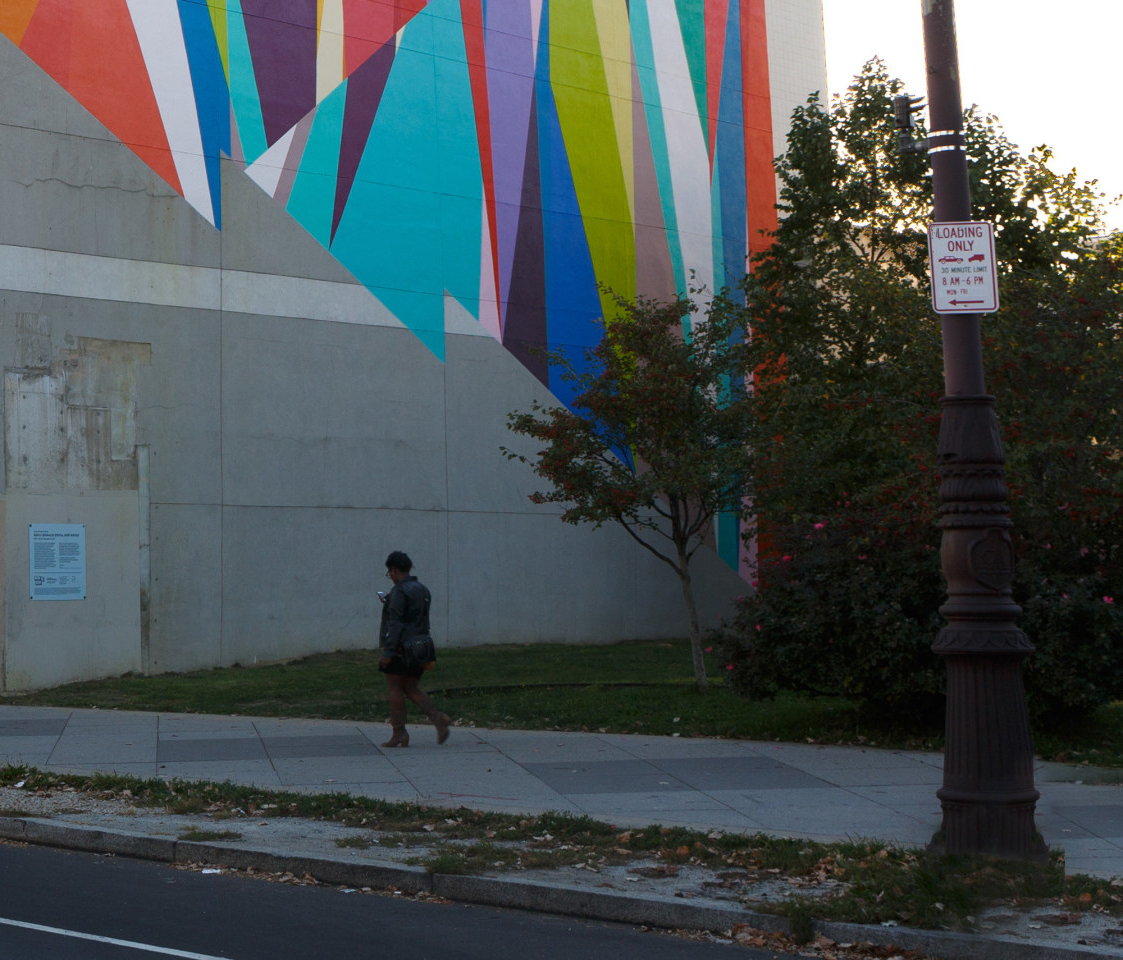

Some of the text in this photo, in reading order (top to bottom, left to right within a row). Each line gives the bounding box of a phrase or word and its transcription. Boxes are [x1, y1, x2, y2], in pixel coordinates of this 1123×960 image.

[937, 227, 983, 239] LOADING
[947, 240, 974, 252] ONLY
[951, 266, 972, 274] MINUTE
[974, 276, 984, 285] PM
